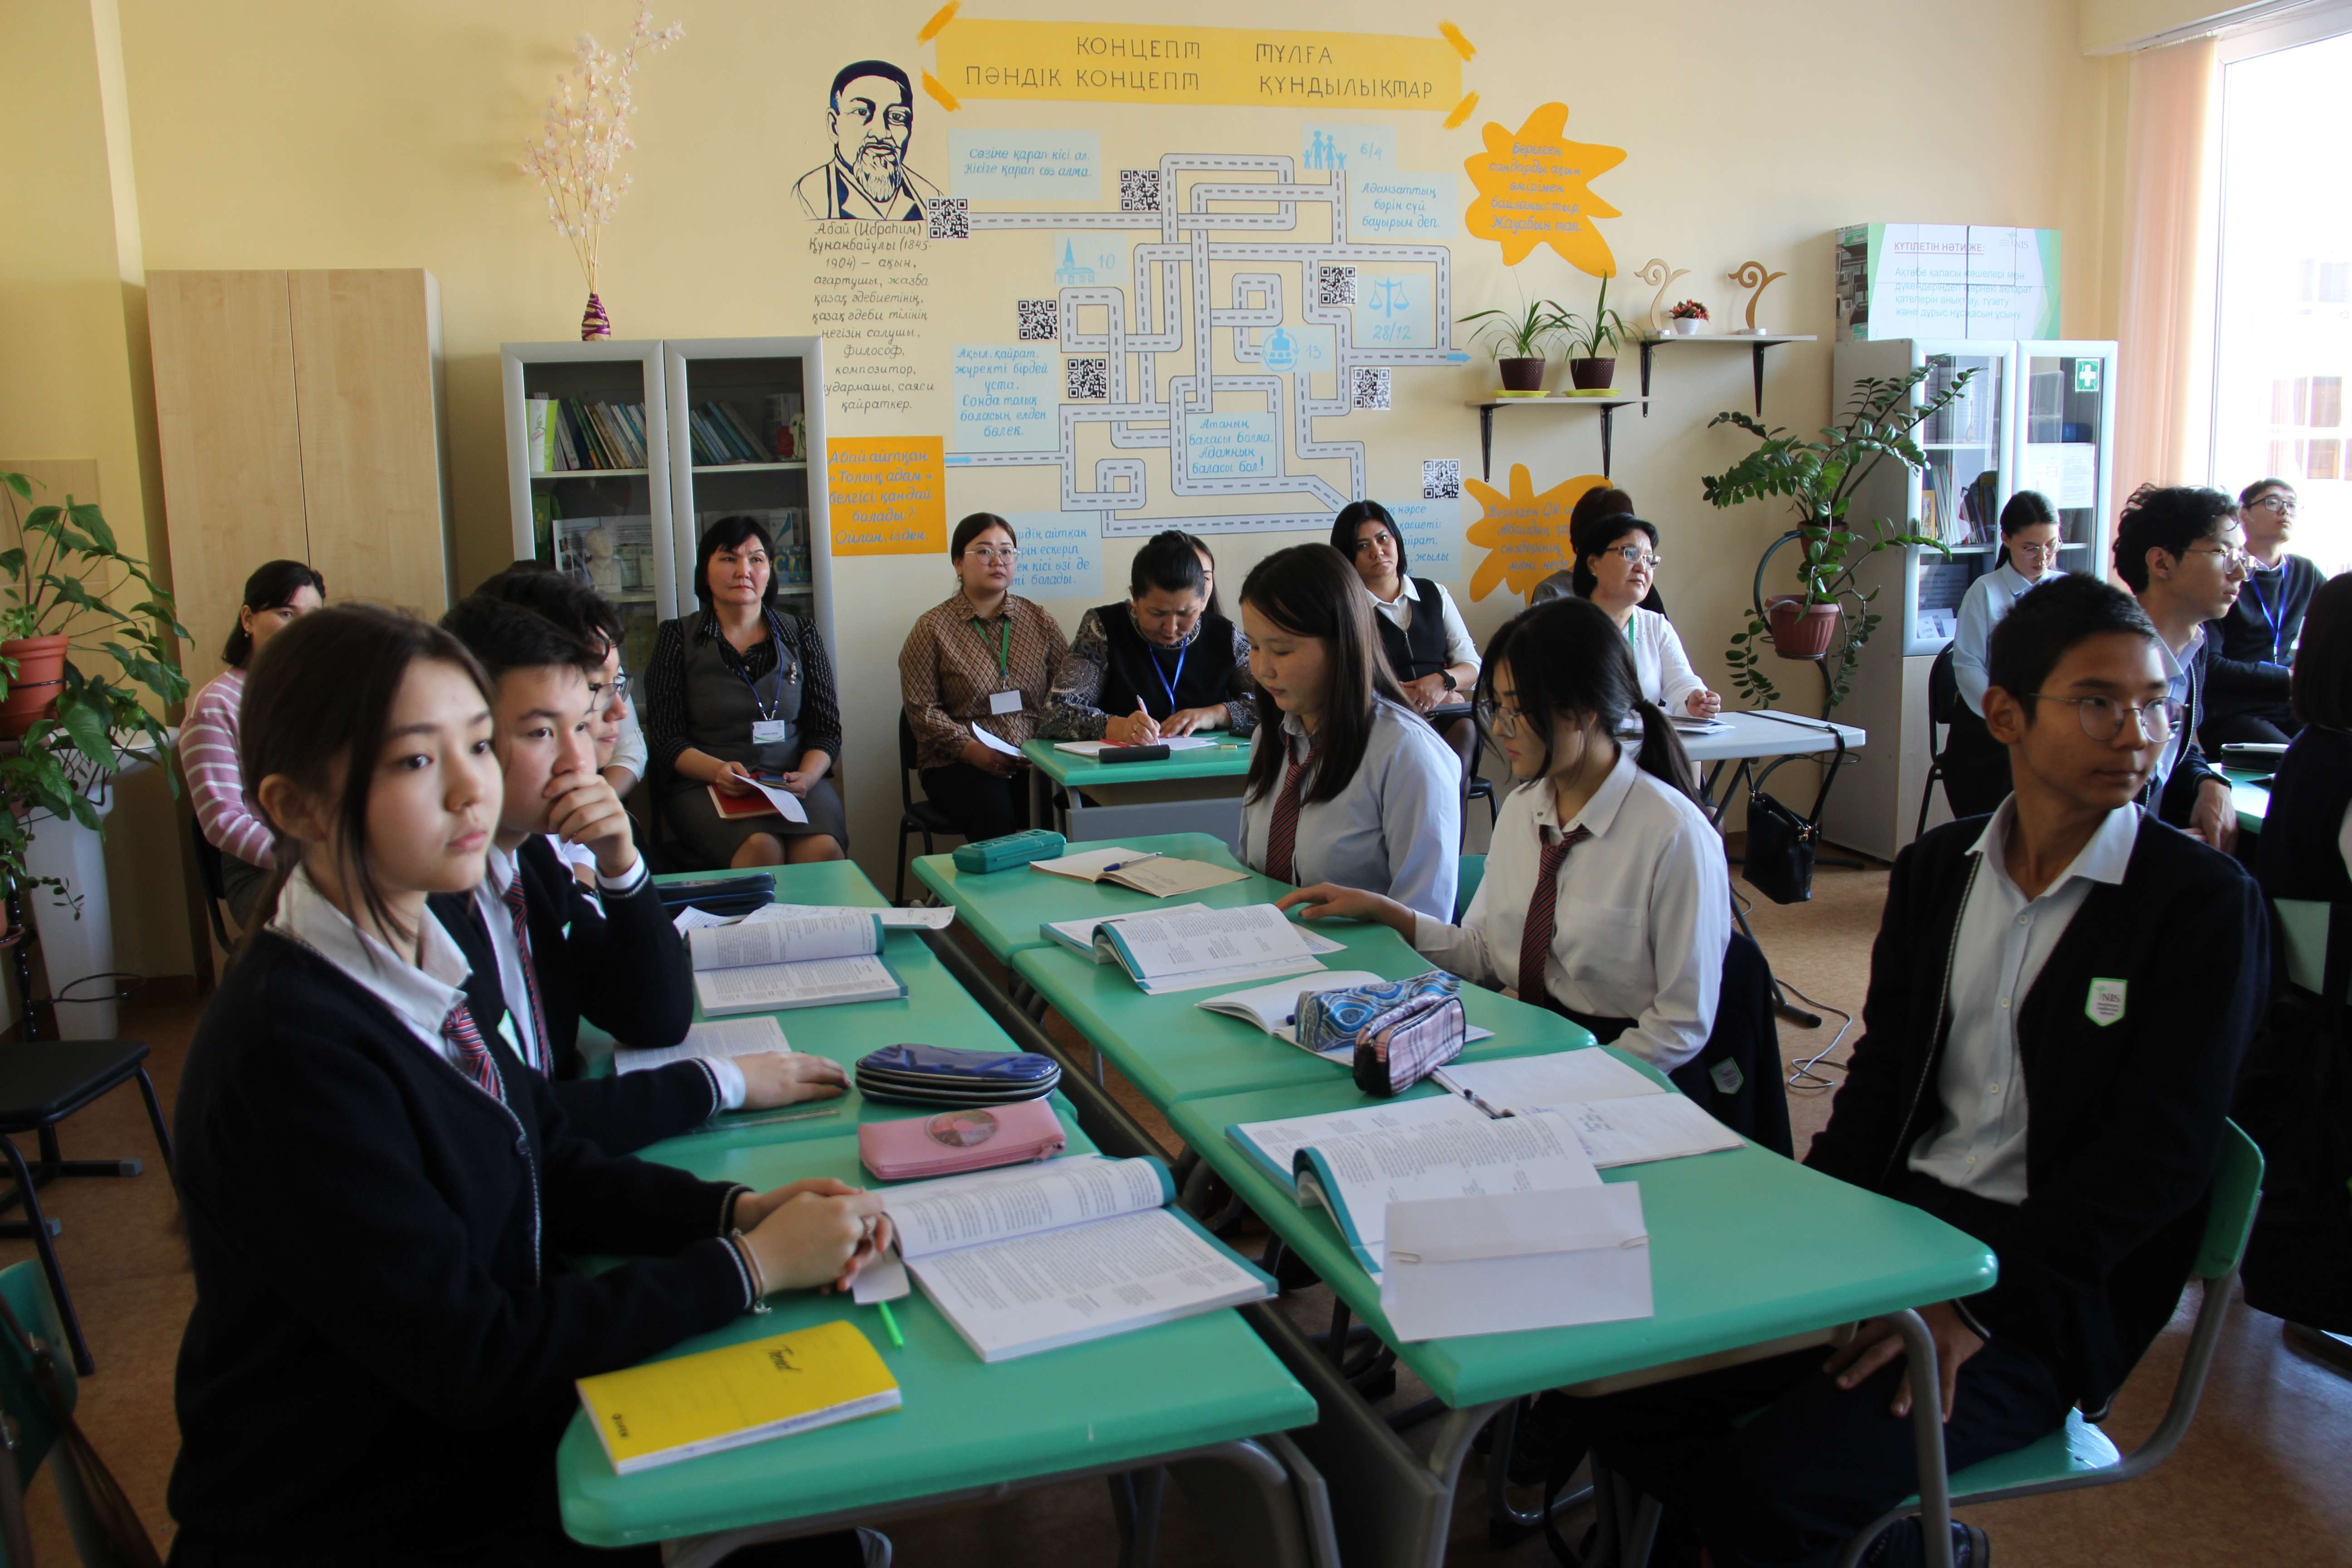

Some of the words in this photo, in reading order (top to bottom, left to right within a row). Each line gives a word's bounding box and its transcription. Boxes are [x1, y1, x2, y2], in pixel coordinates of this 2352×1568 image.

[1077, 36, 1200, 61] КОНЦЕПТ
[1256, 43, 1333, 64] ТҰЛҒА
[966, 66, 1062, 88] ПӘНДІК
[1077, 69, 1199, 91] КОНЦЕПТ
[1260, 76, 1432, 98] ҚҰНДЫЛЫҚТАР
[969, 147, 1009, 158] Сөзіне
[1014, 149, 1047, 163] қарап
[1052, 148, 1070, 160] кісі
[1001, 164, 1034, 179] қарап
[1039, 167, 1055, 176] сөз
[1361, 182, 1436, 199] Адамзаттың
[1374, 198, 1402, 214] бәрін
[814, 221, 849, 235] Абай
[1362, 215, 1412, 232] бауырым
[1894, 241, 1939, 251] КҮТІЛЕТІН
[825, 255, 856, 270] 1904)
[878, 258, 916, 269] ақын,
[1098, 254, 1115, 269] 10
[887, 273, 928, 286] жазба
[1895, 267, 1927, 277] Ақтөбе
[1930, 269, 1961, 278] қаласы
[814, 294, 847, 306] қазақ
[1896, 295, 1938, 304] қателерін
[813, 312, 844, 324] қазақ
[848, 309, 883, 320] әдеби
[889, 308, 927, 320] тілінің
[822, 327, 861, 338] негізін
[867, 329, 920, 345] салушы,
[1373, 322, 1411, 342] 28/12
[844, 344, 904, 359] философ,
[835, 366, 916, 377] композитор,
[1013, 360, 1048, 377] бірдей
[842, 398, 911, 414] қайраткер.
[962, 394, 1000, 407] Сонда
[1004, 396, 1037, 407] толық
[1016, 407, 1046, 420] елден
[1200, 418, 1250, 429] Атаның
[1189, 433, 1230, 445] баласы
[828, 450, 867, 465] Абай
[1199, 446, 1255, 458] Адамның
[1192, 462, 1233, 474] баласы
[828, 490, 876, 505] белгісі
[881, 486, 931, 504] қандай
[1398, 506, 1426, 515] нәрсе
[1045, 527, 1087, 539] айтқан
[1040, 543, 1078, 558] ескеріп
[1415, 553, 1449, 561] жылы
[1033, 558, 1052, 571] кісі
[1077, 557, 1090, 570] де
[2102, 993, 2120, 1002] NIS
